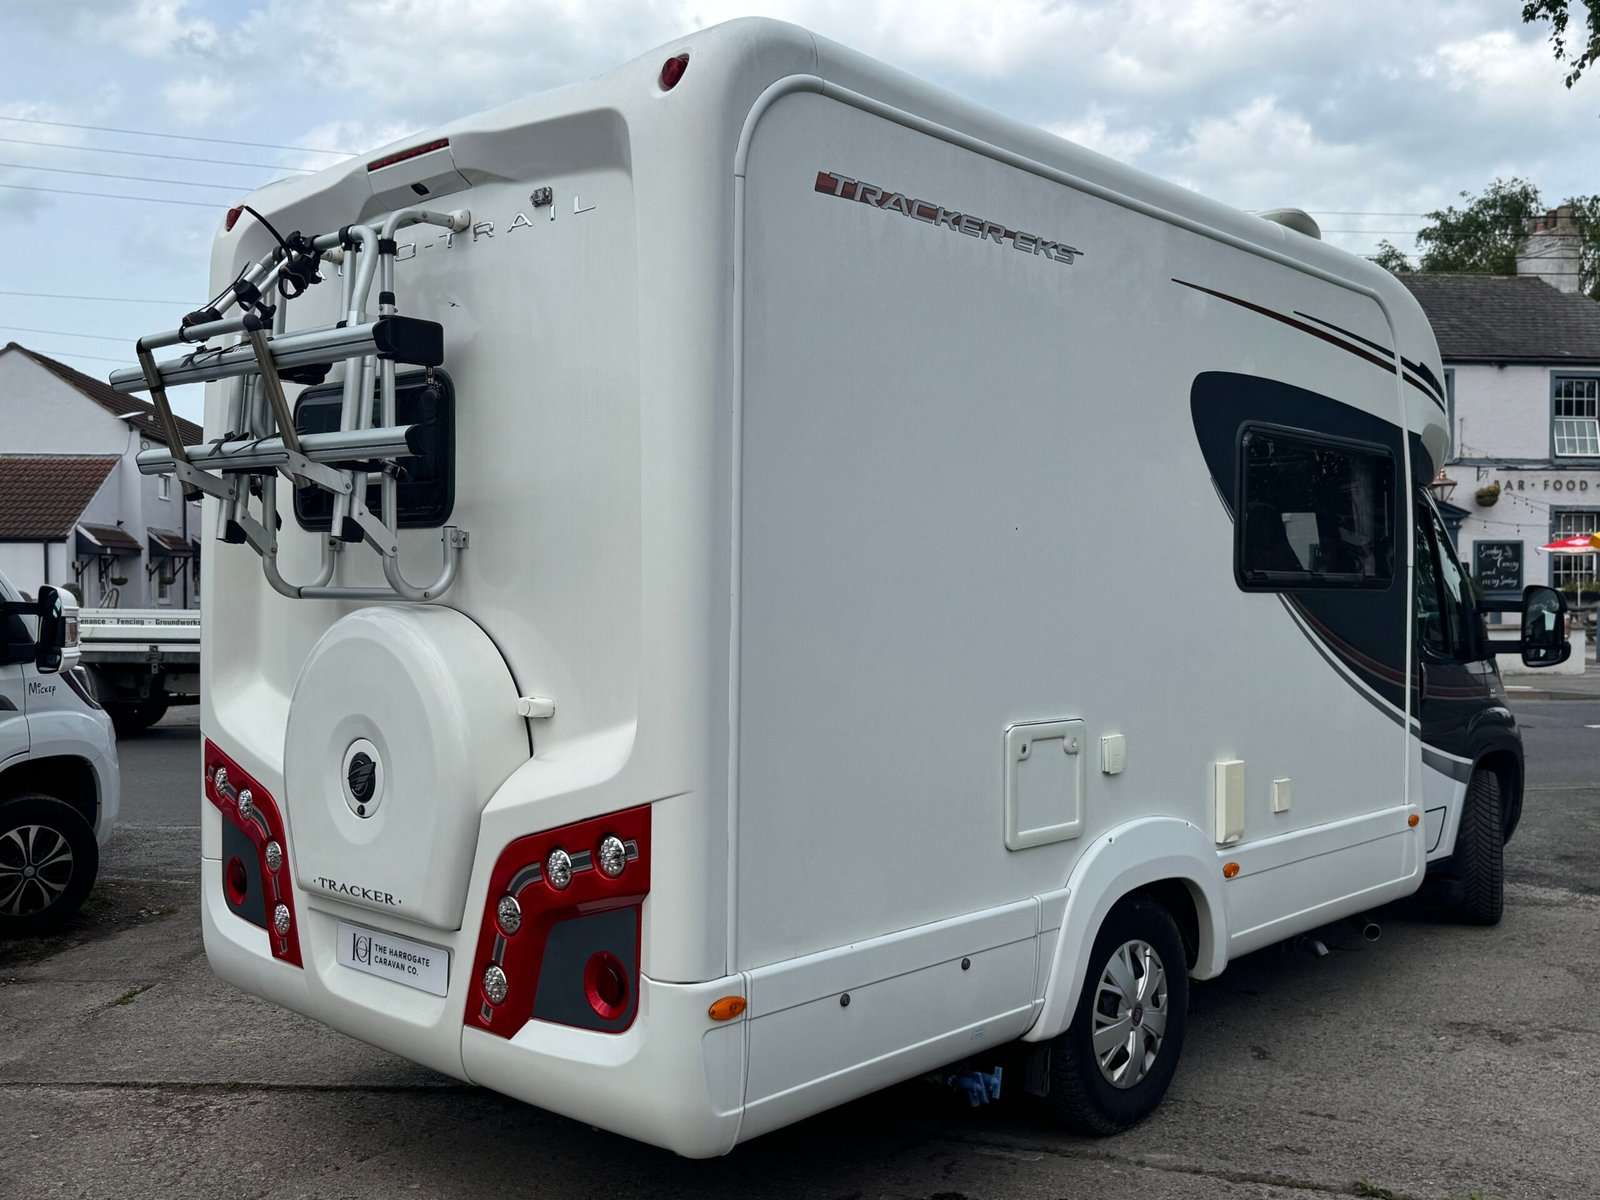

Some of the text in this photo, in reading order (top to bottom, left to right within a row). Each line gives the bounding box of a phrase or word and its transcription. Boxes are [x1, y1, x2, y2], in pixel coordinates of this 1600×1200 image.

[828, 171, 1003, 245] TRACKER
[1543, 480, 1588, 491] FOOD
[116, 618, 145, 626] Fencing
[155, 618, 200, 626] Groundworks
[318, 876, 397, 906] TRACKER
[374, 955, 419, 977] CARAVAN CO.
[375, 943, 431, 968] THE HARROGATE
